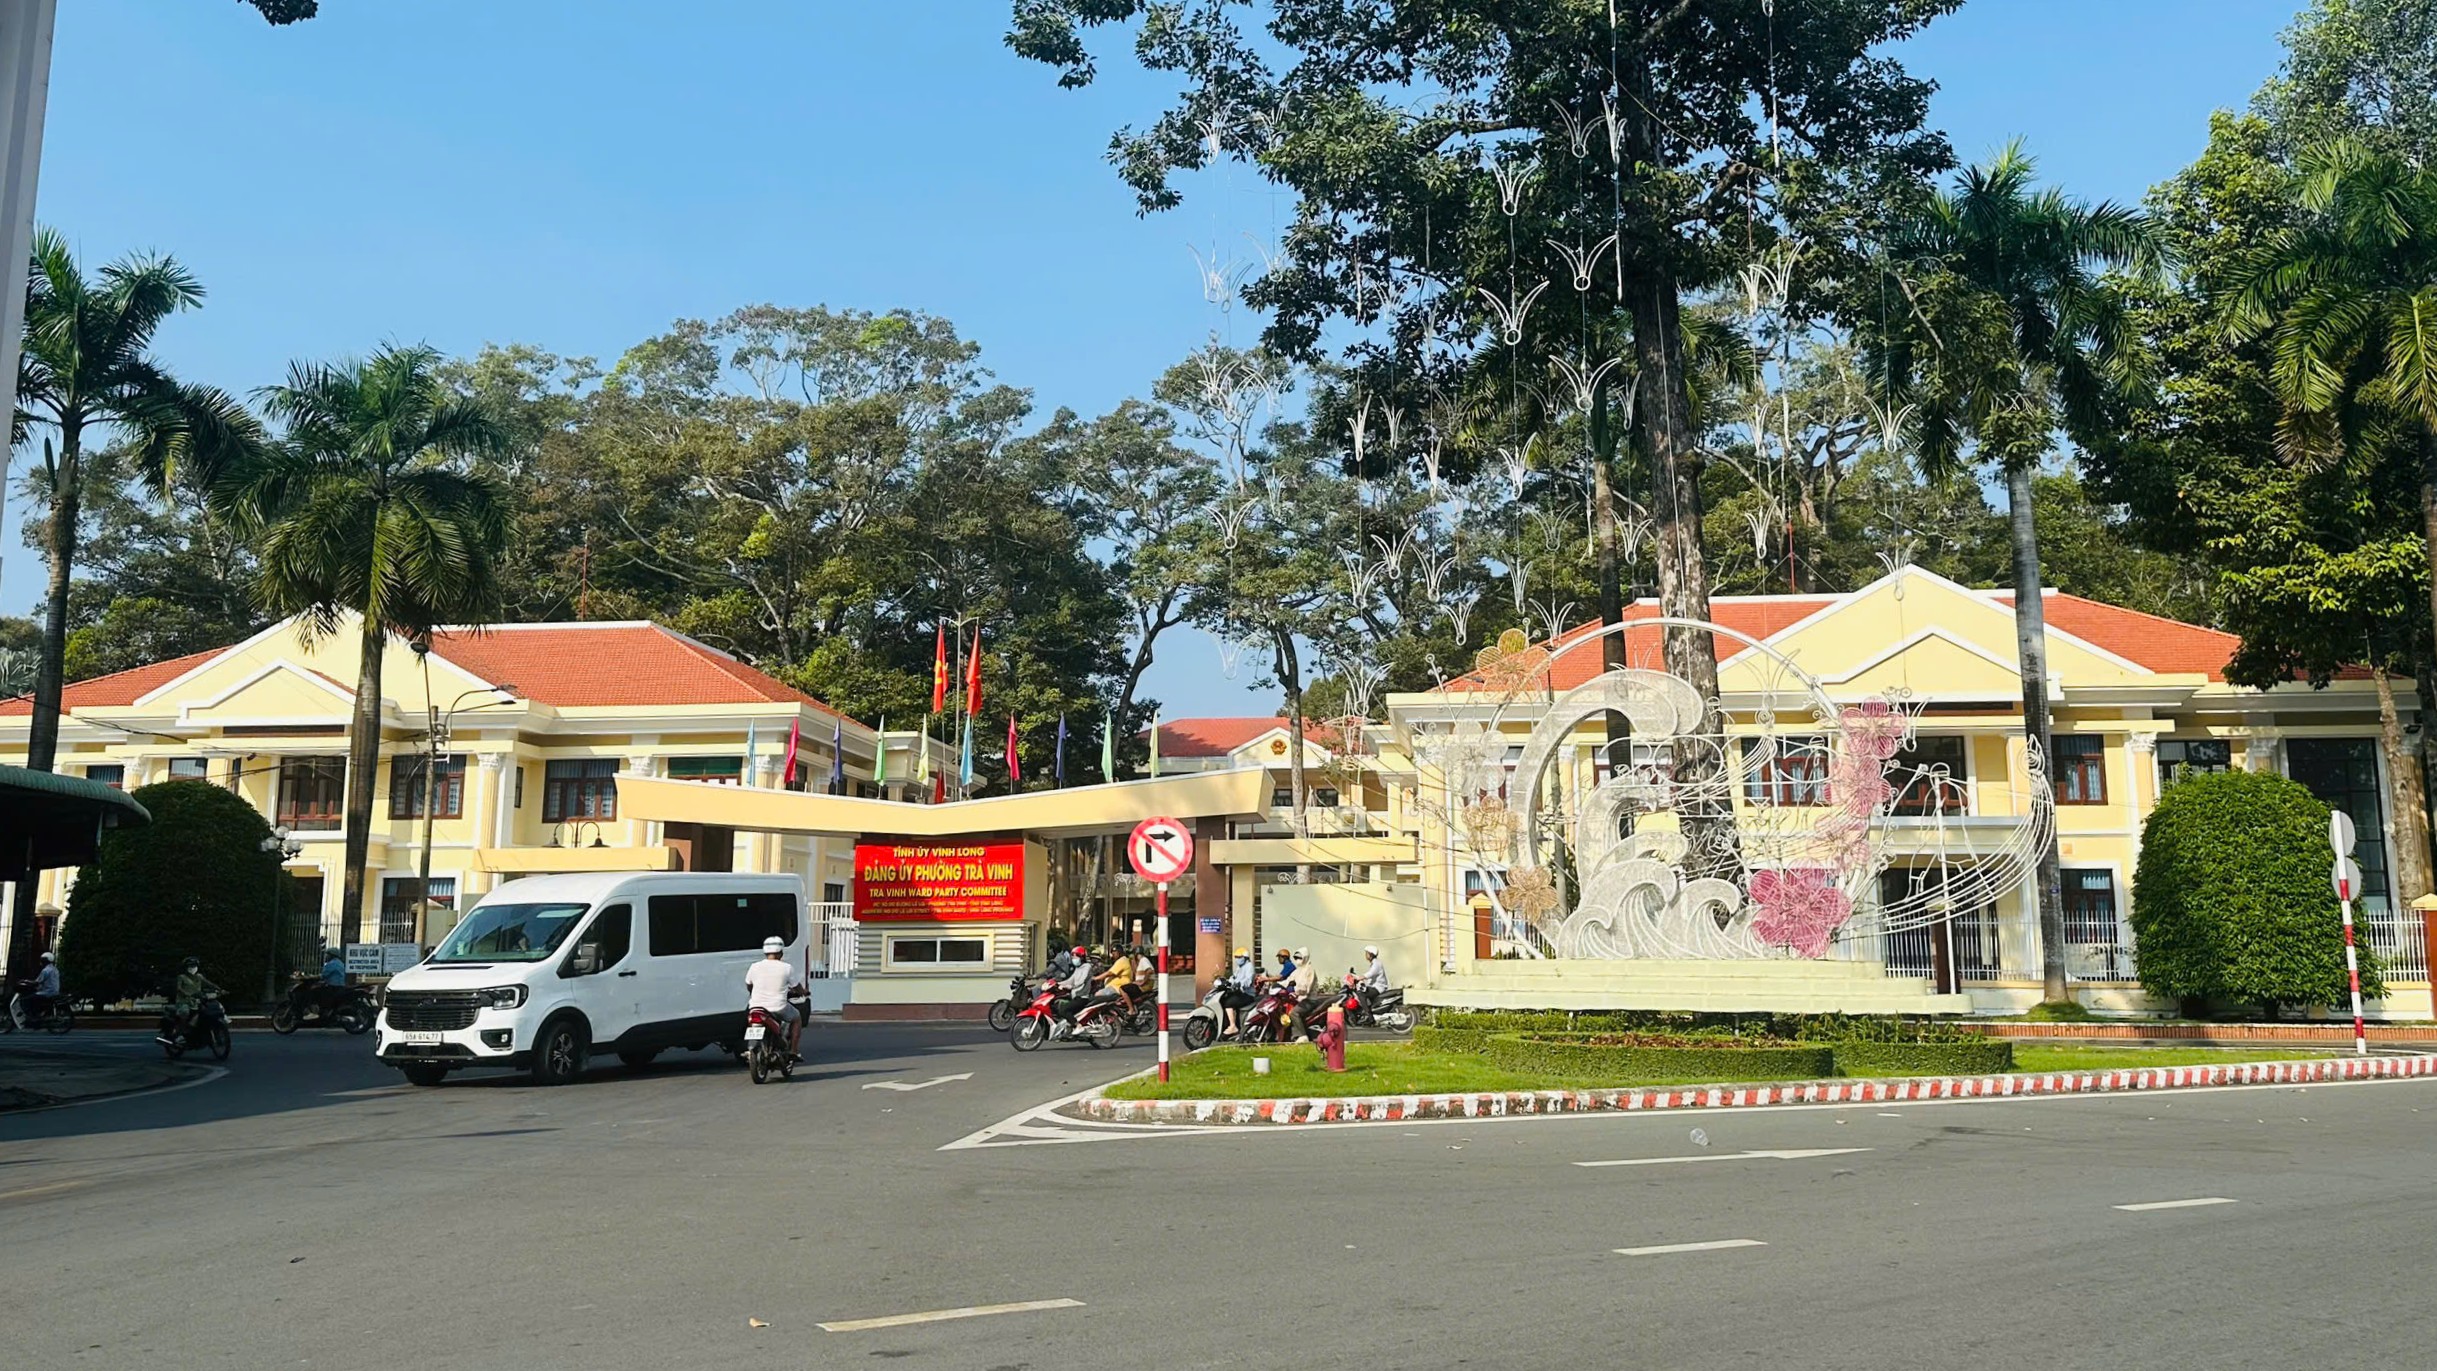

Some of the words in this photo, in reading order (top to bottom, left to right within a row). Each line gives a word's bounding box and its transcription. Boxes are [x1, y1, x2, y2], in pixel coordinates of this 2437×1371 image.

[957, 847, 985, 857] LONG
[864, 859, 896, 881] ĐẢNG
[900, 858, 913, 881] ỦY
[915, 859, 962, 881] PHƯỜNG
[965, 858, 984, 881] TRÀ
[987, 863, 1013, 880] VINH
[870, 888, 884, 897] TRA
[886, 888, 906, 897] VINH
[908, 887, 933, 897] WARD
[934, 887, 959, 897] PARTY
[961, 886, 1007, 896] COMMITTEE
